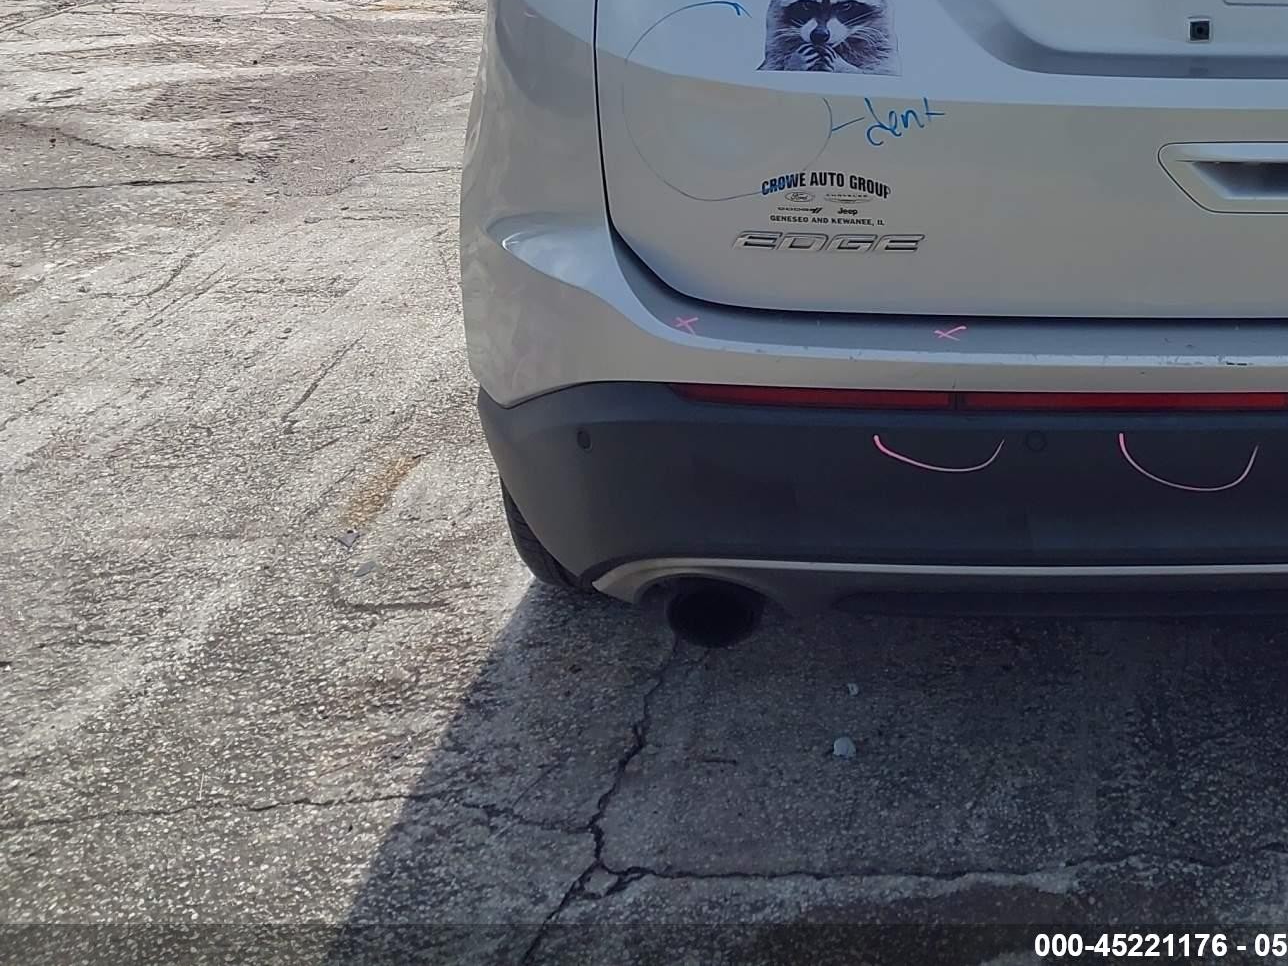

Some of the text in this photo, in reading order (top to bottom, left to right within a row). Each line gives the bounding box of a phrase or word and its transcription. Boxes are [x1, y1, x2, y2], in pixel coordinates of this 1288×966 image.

[864, 97, 946, 146] dent
[761, 171, 891, 199] CROWE AUTO GROUP
[770, 215, 809, 223] GENESEO
[838, 207, 858, 216] Jeep
[733, 230, 926, 253] EDGE
